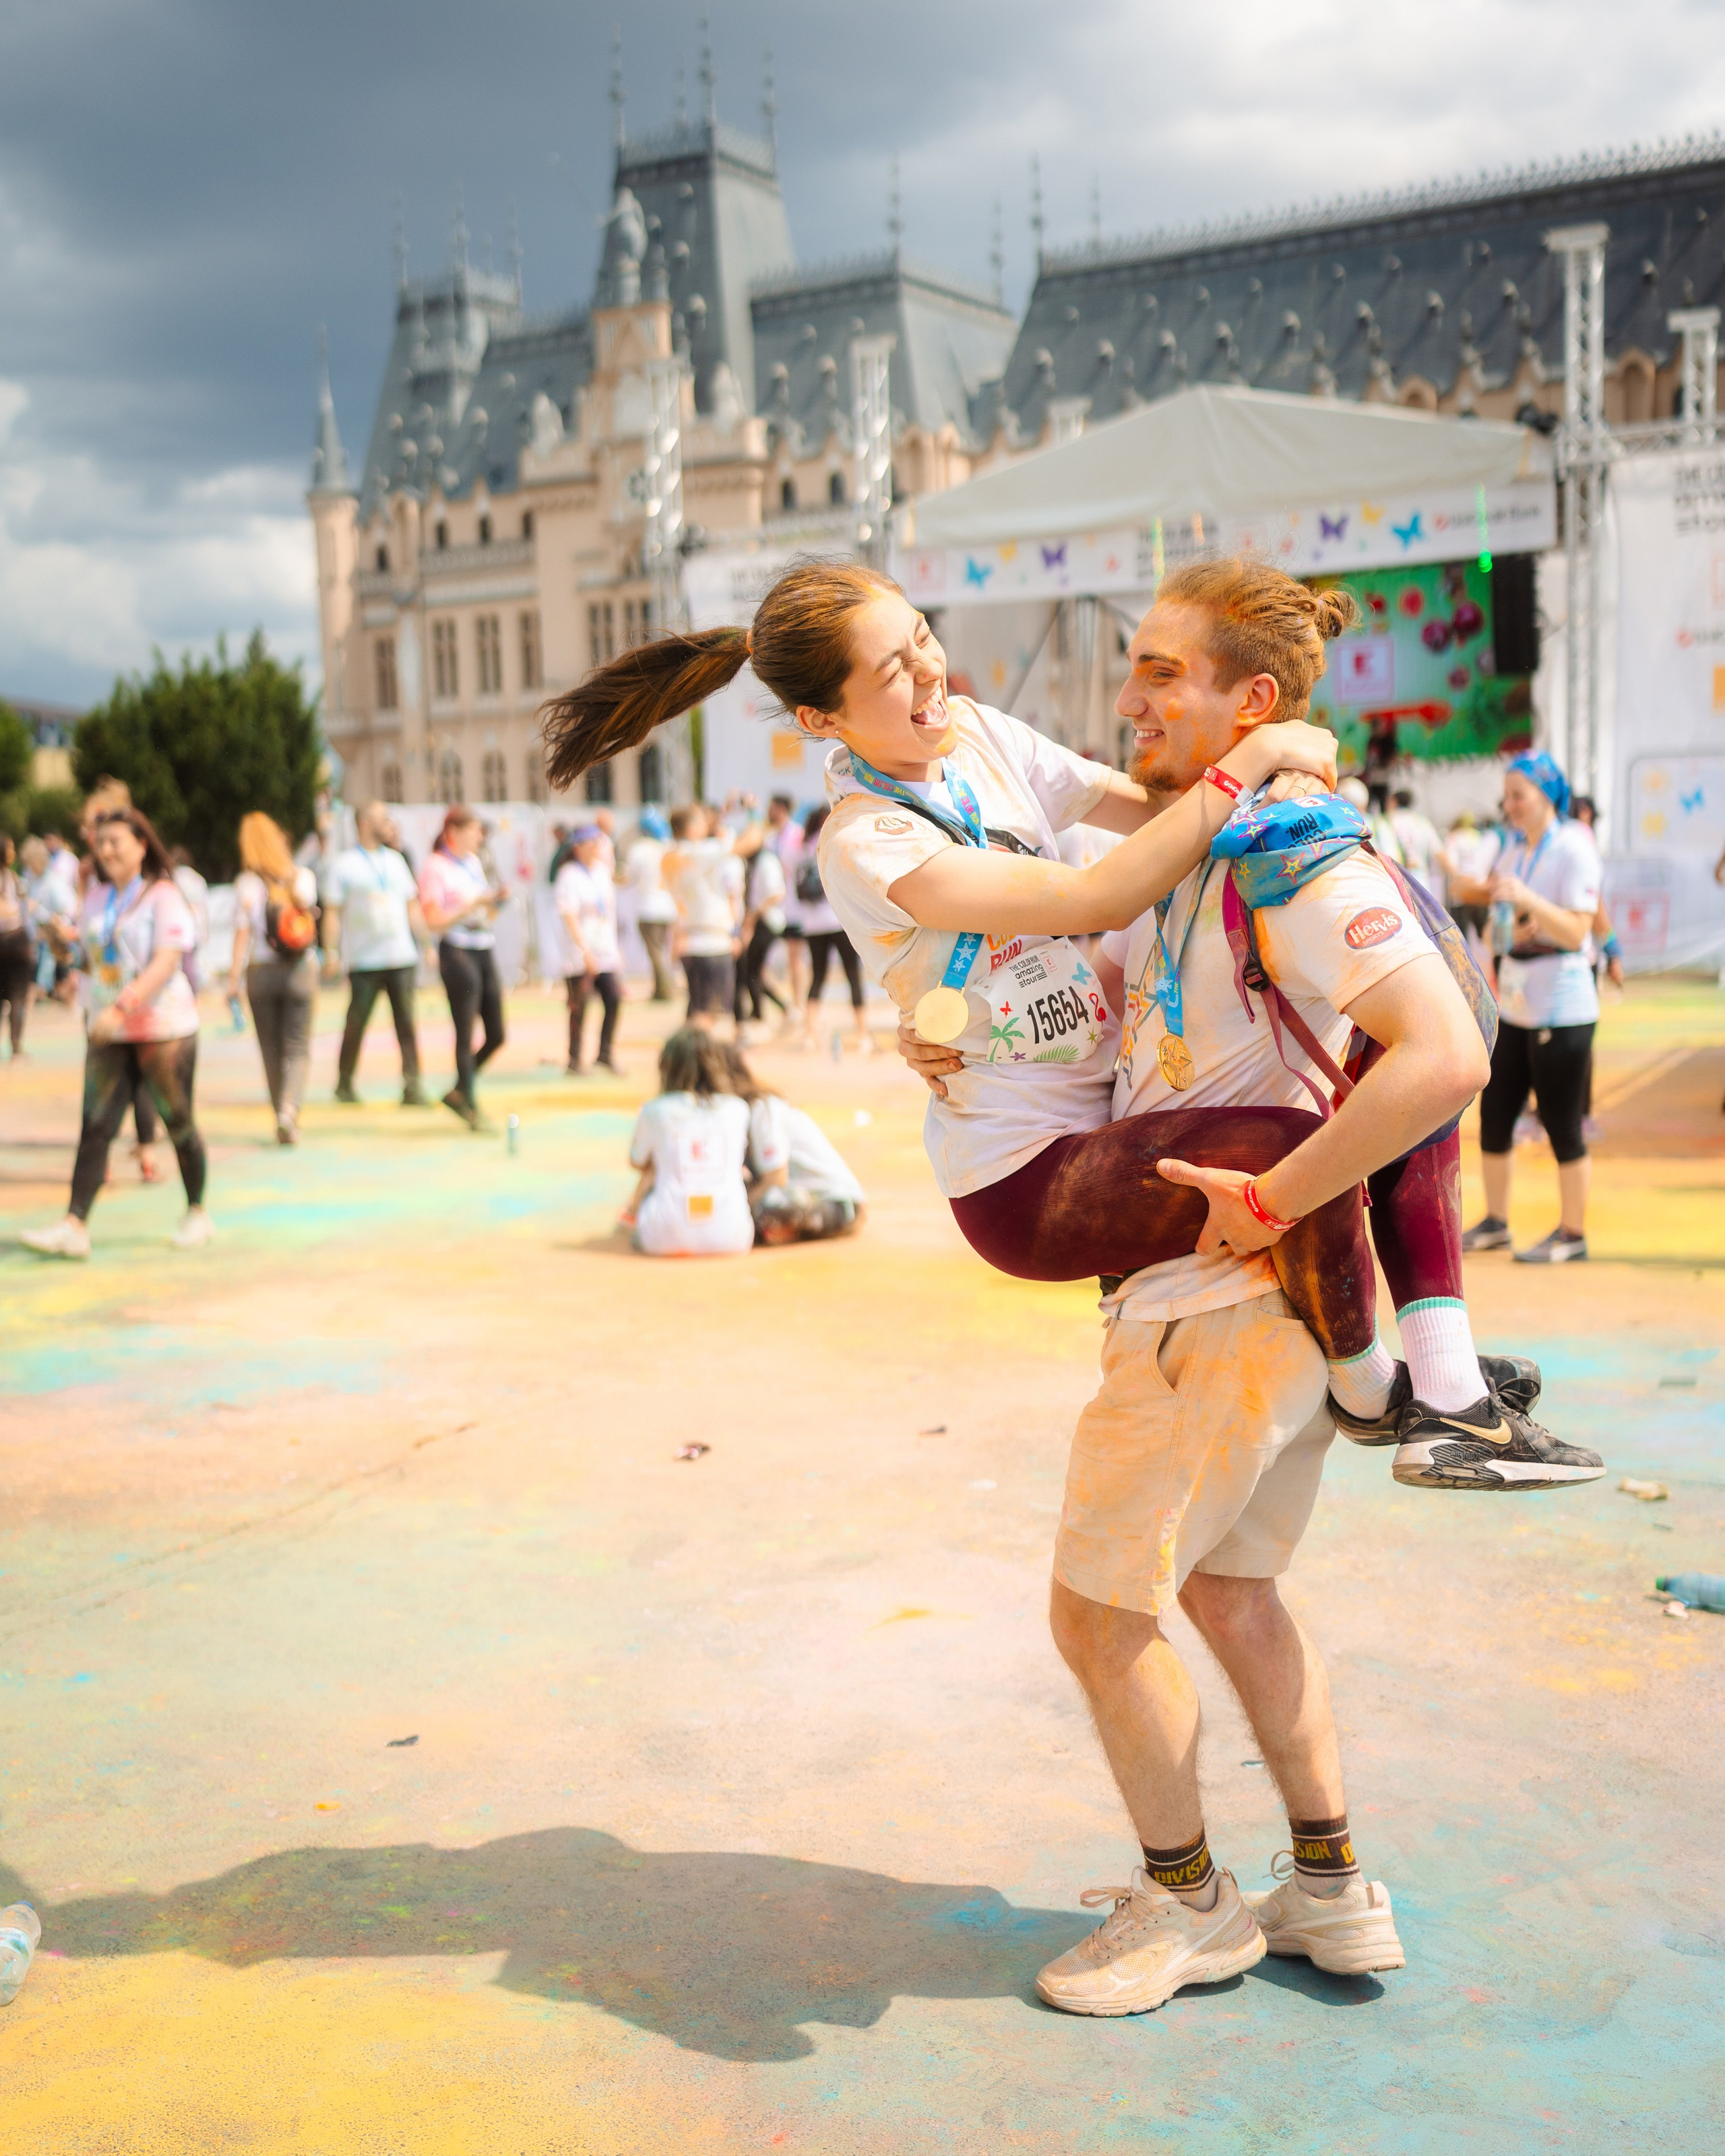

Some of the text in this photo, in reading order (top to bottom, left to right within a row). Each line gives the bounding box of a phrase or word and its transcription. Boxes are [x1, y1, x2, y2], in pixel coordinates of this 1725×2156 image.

[873, 778, 894, 792] COLOR
[894, 786, 905, 796] THE
[960, 796, 975, 815] COLOR
[970, 812, 980, 826] RUN
[1284, 829, 1327, 850] COL
[1348, 914, 1398, 944] Hervis
[1362, 930, 1385, 945] SPORTS
[1008, 963, 1021, 972] THE
[1017, 957, 1032, 969] COLOR
[1015, 963, 1044, 980] amazing
[1022, 975, 1038, 986] tour
[1026, 986, 1089, 1044] 15654
[1450, 1451, 1463, 1459] AIR
[1154, 1845, 1210, 1884] DIVISIO
